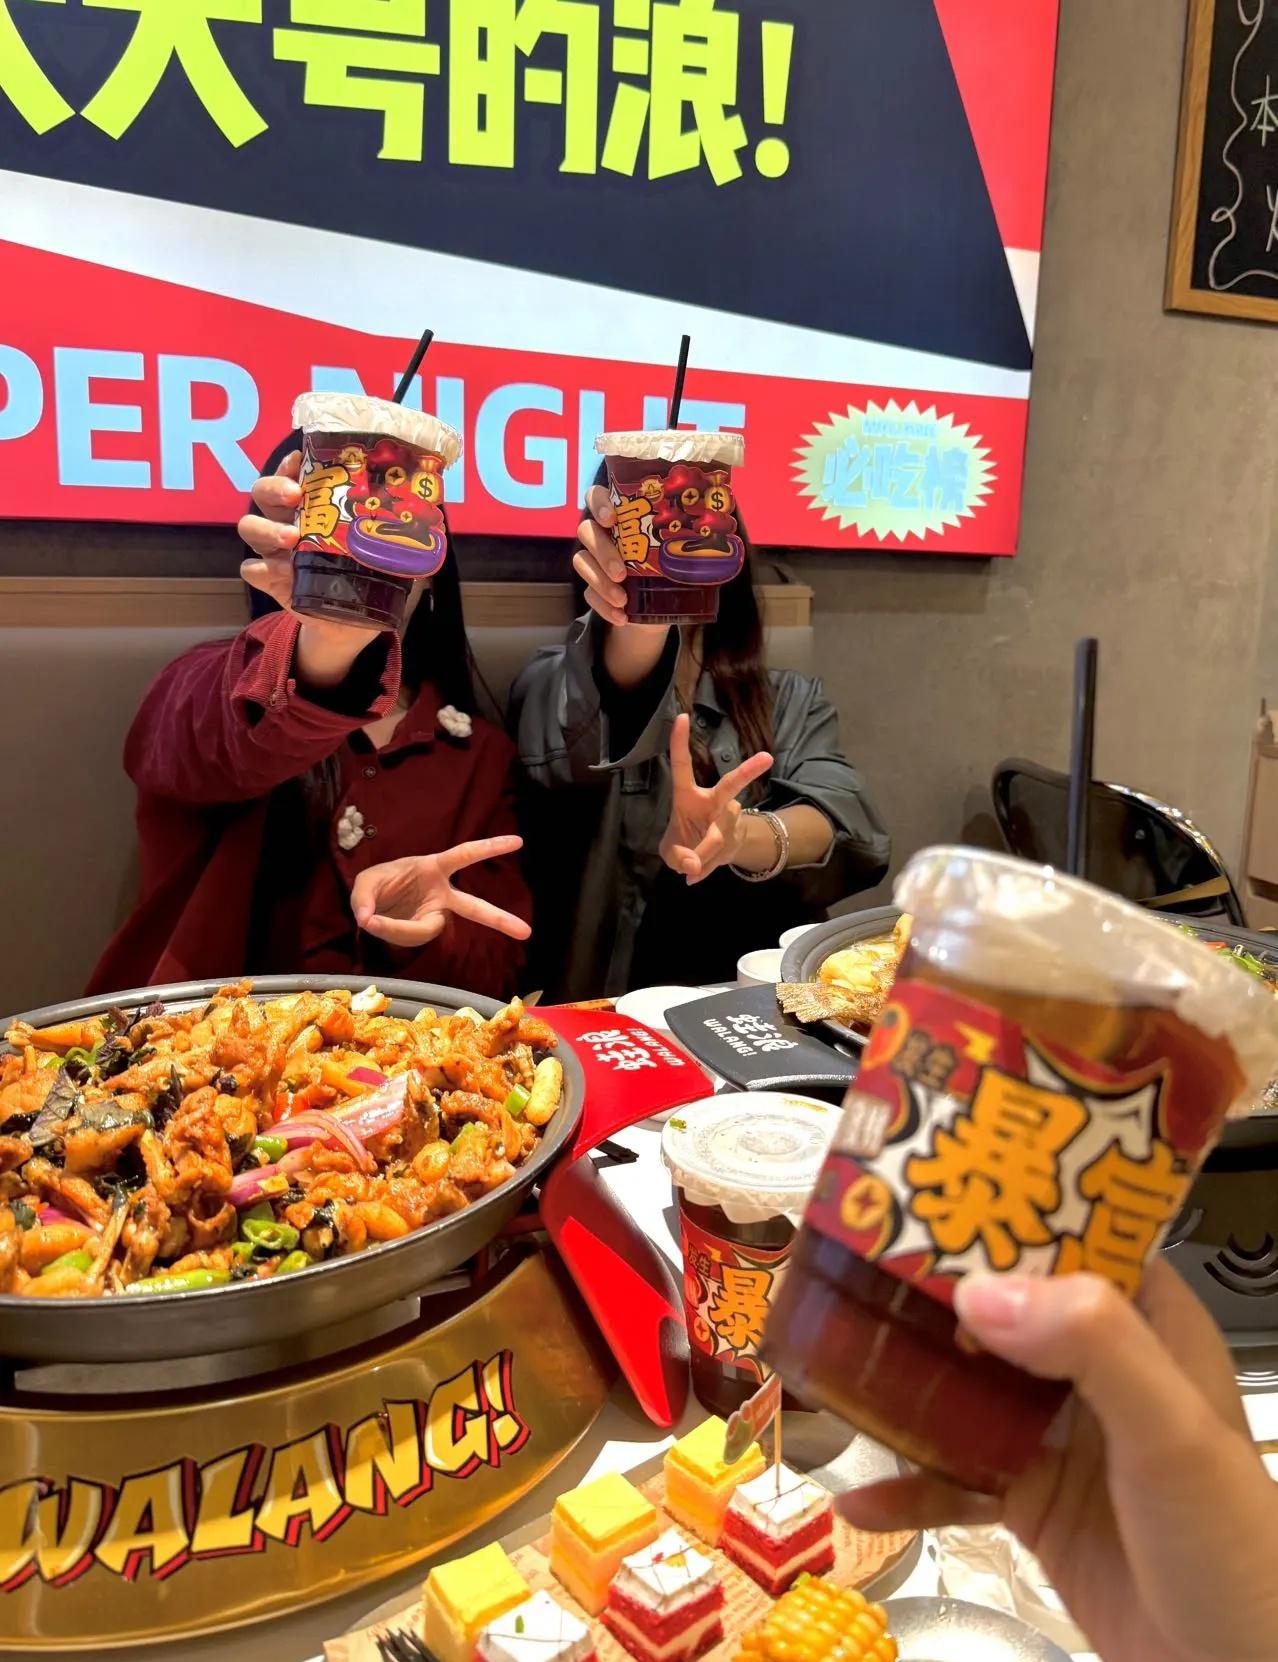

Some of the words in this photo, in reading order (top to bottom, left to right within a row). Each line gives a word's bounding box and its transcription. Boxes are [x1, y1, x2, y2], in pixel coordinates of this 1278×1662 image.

[703, 1018, 758, 1057] WALANG!
[726, 1014, 798, 1052] 蛙浪
[0, 1349, 531, 1593] WALANG!
